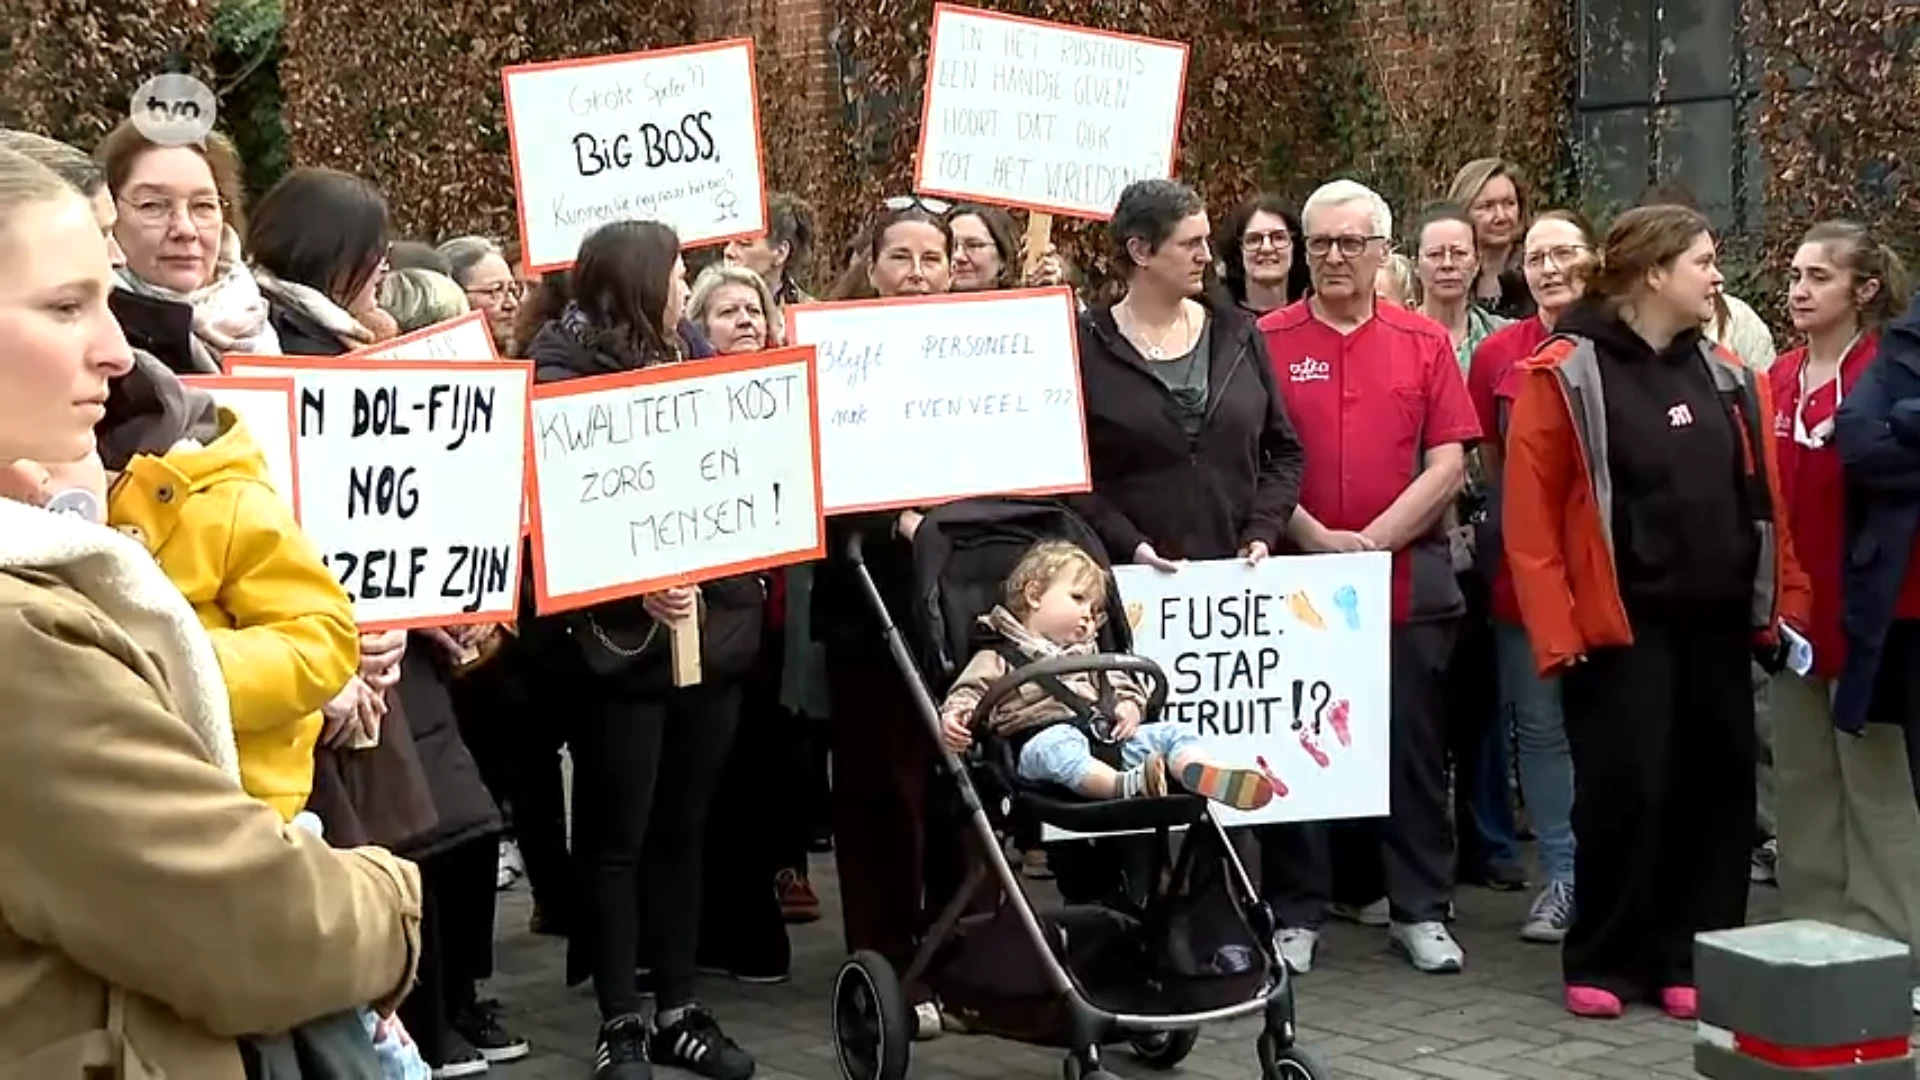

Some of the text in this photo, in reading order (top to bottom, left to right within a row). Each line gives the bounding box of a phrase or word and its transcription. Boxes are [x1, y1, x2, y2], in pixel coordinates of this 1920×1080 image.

[958, 23, 1146, 76] IN HET RUSTHUIS
[568, 80, 633, 116] Grote
[938, 60, 977, 90] EEN
[1074, 76, 1130, 110] GEVEN
[943, 107, 1112, 150] HOORT DAT OOK
[937, 150, 974, 181] TOT
[992, 155, 1033, 191] HET
[922, 331, 1036, 359] PERSONEEL
[350, 384, 496, 451] DOL-FIJN
[538, 374, 799, 460] KWALITEIT KOST
[346, 465, 420, 519] NOG
[579, 446, 741, 504] ZORG EN
[629, 494, 756, 557] MENSEN
[439, 544, 511, 613] ZIJN
[1174, 647, 1281, 696] STAP
